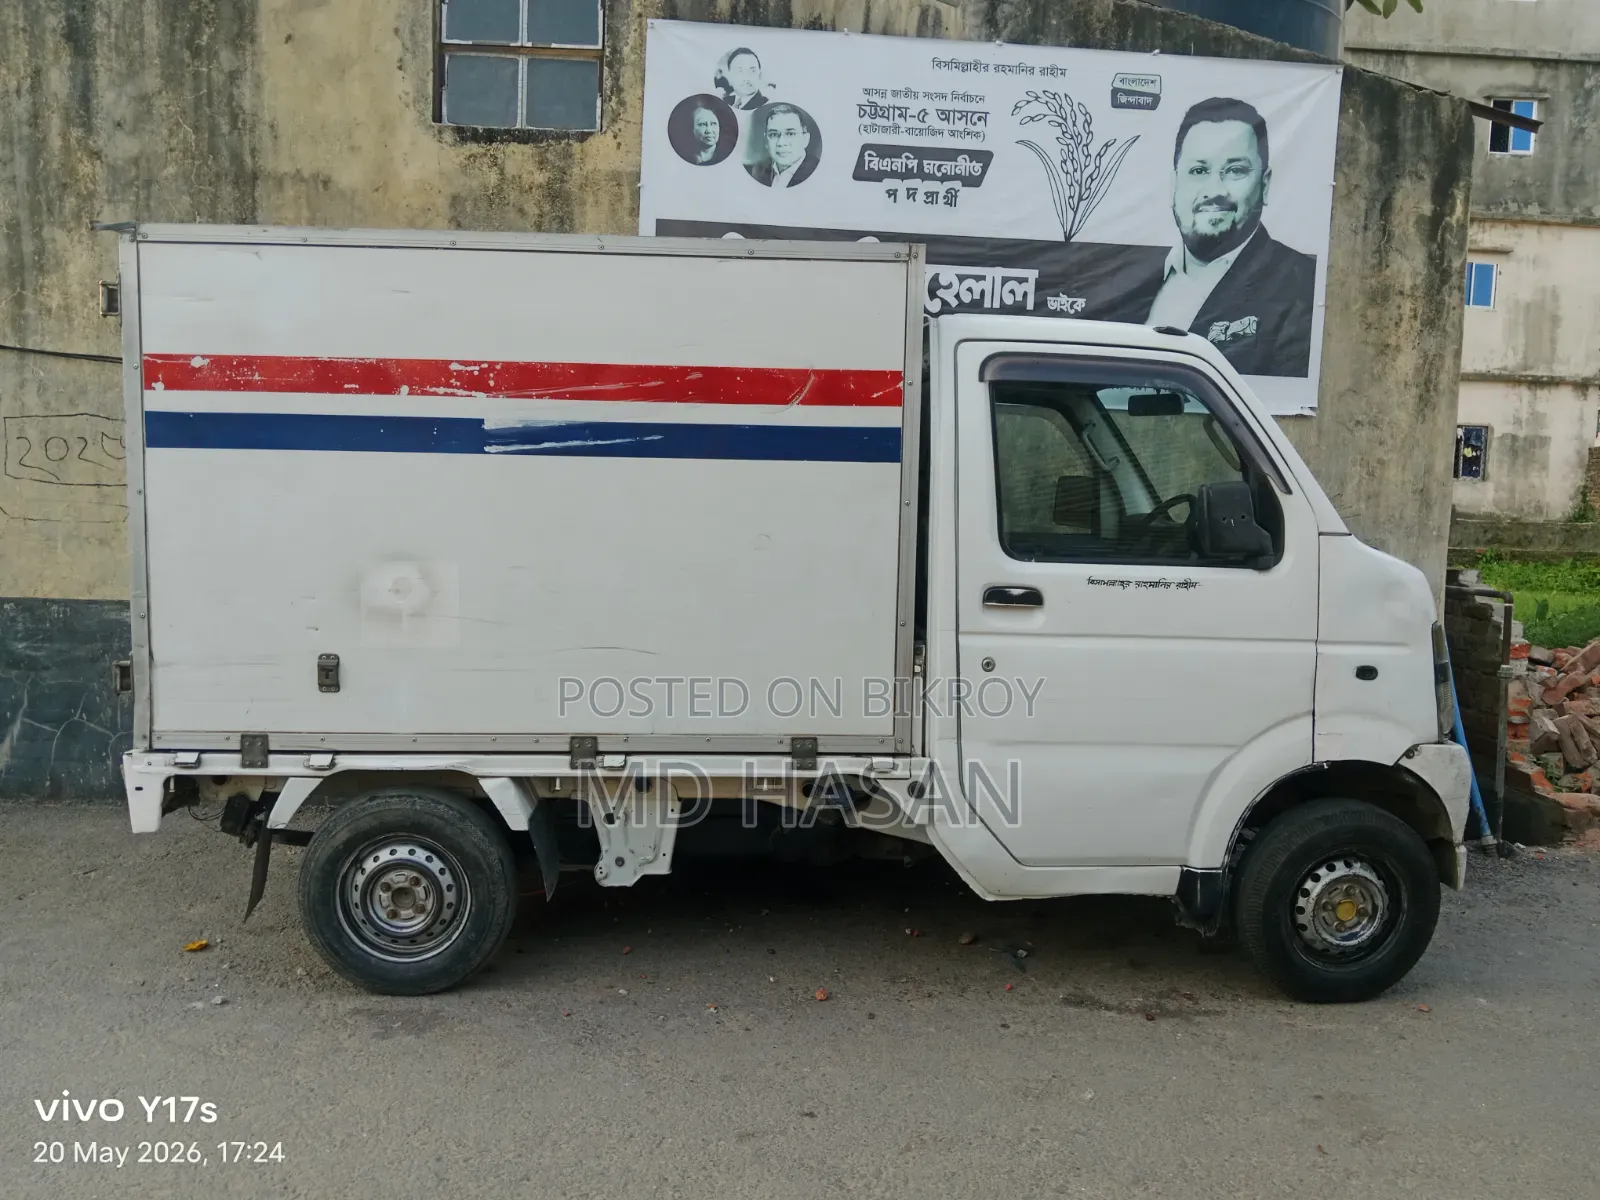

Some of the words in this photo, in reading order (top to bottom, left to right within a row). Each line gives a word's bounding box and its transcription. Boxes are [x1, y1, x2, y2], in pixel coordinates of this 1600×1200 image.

[993, 62, 1035, 76] রহমানির
[1039, 64, 1068, 78] রাহীম
[1118, 76, 1157, 88] বাংলাদেশ
[862, 87, 888, 99] আসন্ন
[890, 87, 919, 100] জাতীয়
[922, 91, 948, 102] সংসদ
[950, 90, 986, 104] নির্বাচনে
[1117, 92, 1154, 106] জিন্দাবাদ
[935, 108, 990, 127] আসনে
[864, 150, 919, 174] বিএনপি
[922, 154, 983, 177] মনোনীত
[924, 264, 1039, 314] হেলাল
[1047, 292, 1087, 315] ভাইকে
